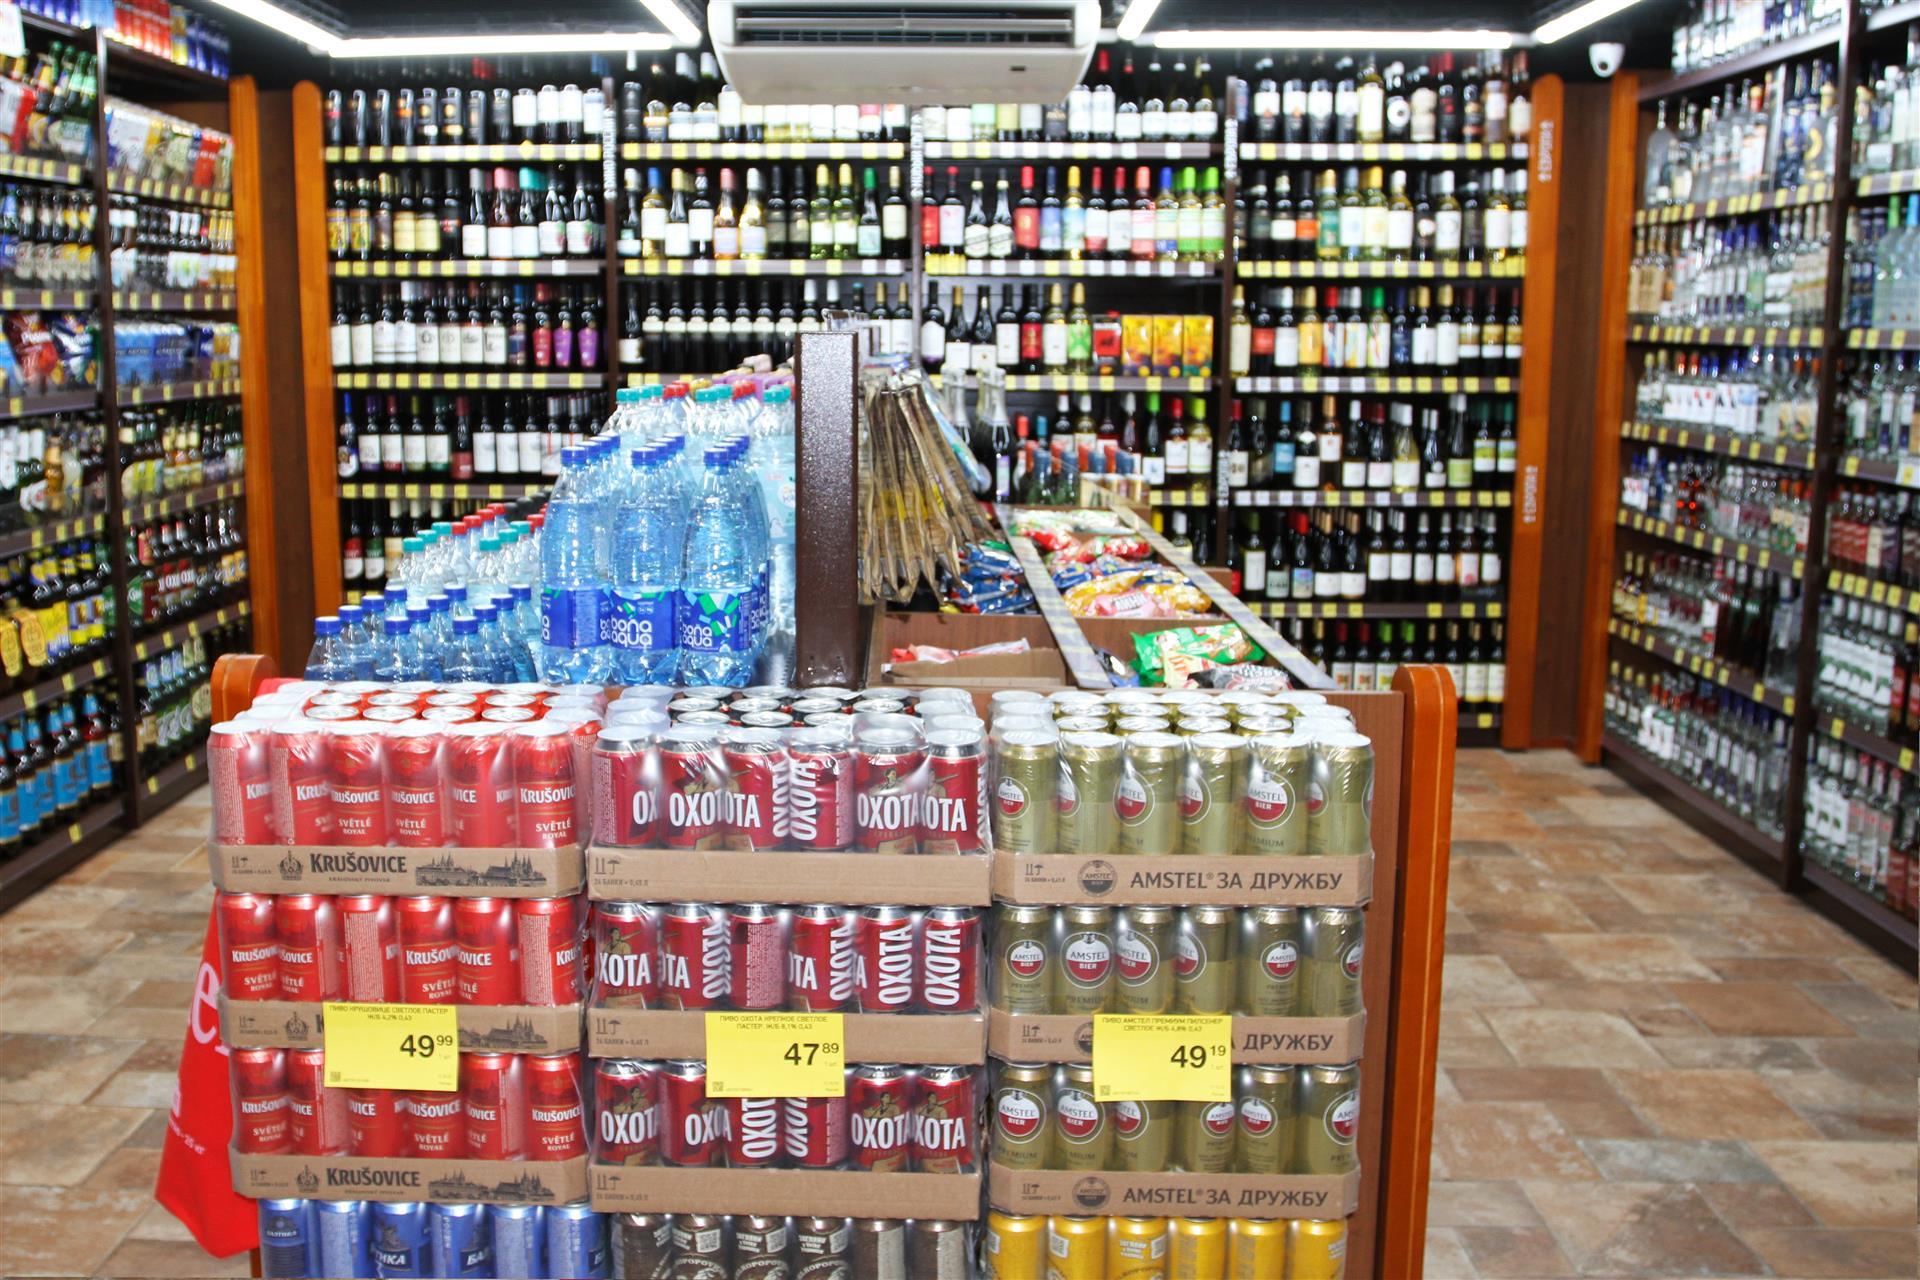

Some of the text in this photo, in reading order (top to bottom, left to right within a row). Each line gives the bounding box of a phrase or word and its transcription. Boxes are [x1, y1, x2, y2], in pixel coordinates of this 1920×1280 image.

[521, 786, 575, 804] KRUŠOVIC
[789, 761, 817, 841] ОХОТА
[1255, 801, 1272, 810] BIER
[536, 818, 571, 832] SVĚTLÉ
[310, 852, 407, 873] KRUŠOVICE
[1216, 872, 1242, 889] ЗА
[1251, 872, 1342, 890] ДРУЖБУ
[830, 923, 852, 1001] ОХОТА
[878, 923, 913, 1005] ОХОТА
[1070, 951, 1106, 961] AMSTEL
[924, 928, 961, 1006] ОХОТА
[1079, 962, 1097, 970] BIER
[400, 1034, 453, 1058] 49 99
[1243, 1034, 1333, 1052] ДРУЖБУ
[784, 1042, 839, 1066] 47 89
[1170, 1045, 1226, 1069] 49 19
[1001, 1106, 1035, 1117] AMSTEL
[1008, 1117, 1025, 1126] BIER
[1066, 1117, 1084, 1127] BIER
[542, 1131, 575, 1145] SVĚTLÉ
[326, 1167, 421, 1187] KRUŠOVICE
[1206, 1189, 1231, 1204] ЗА
[1238, 1189, 1328, 1207] ДРУЖБУ
